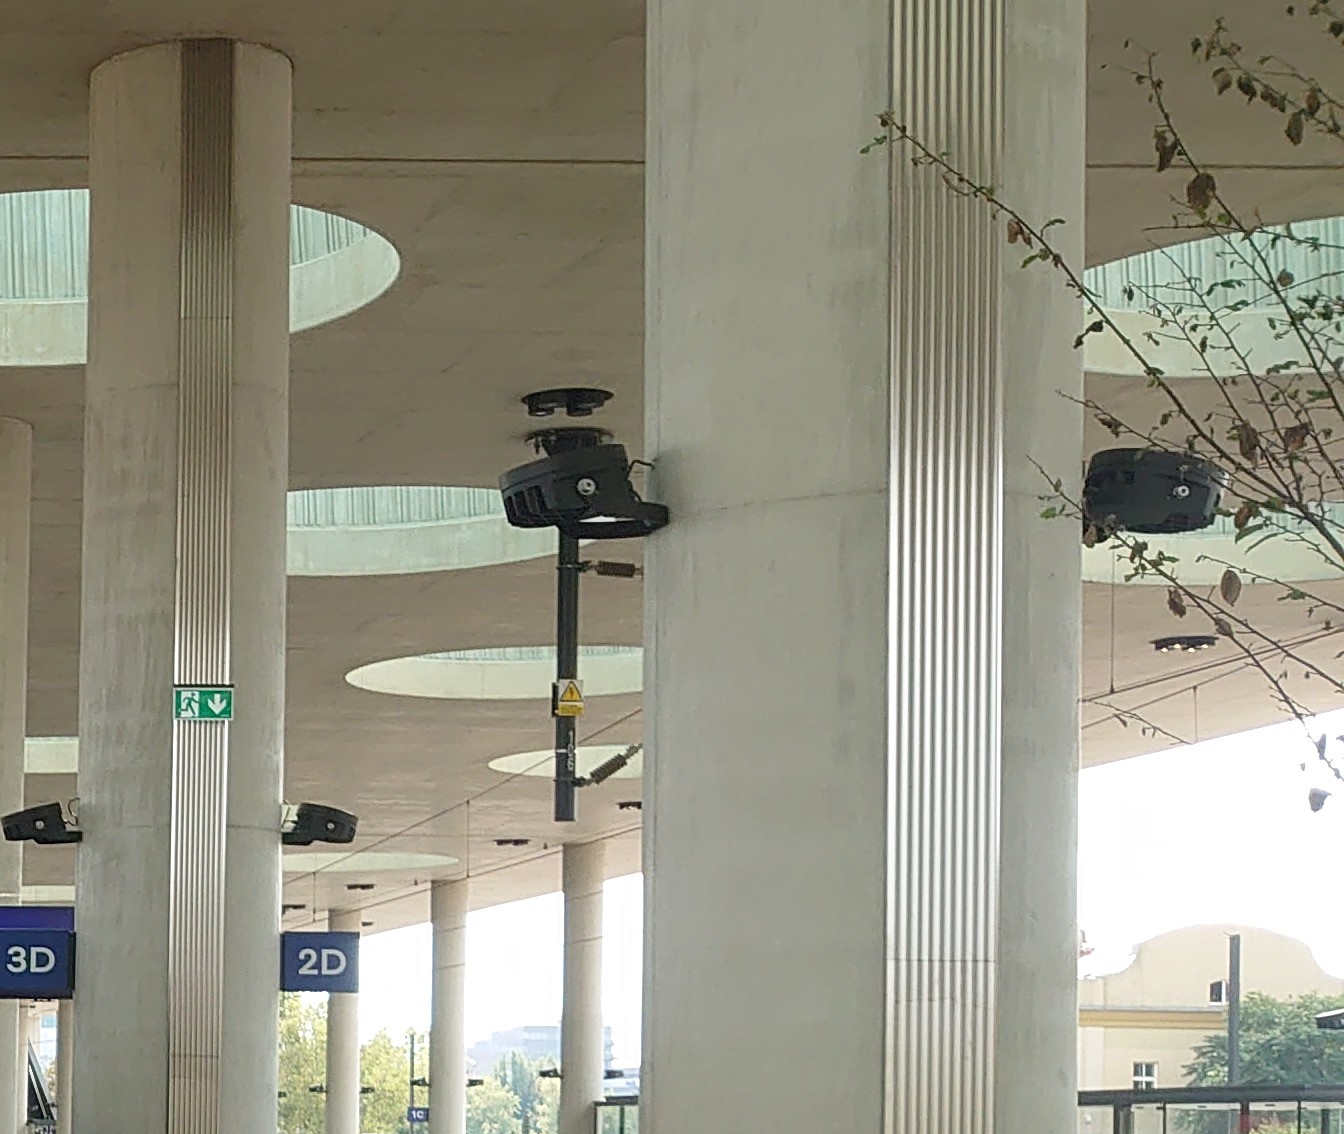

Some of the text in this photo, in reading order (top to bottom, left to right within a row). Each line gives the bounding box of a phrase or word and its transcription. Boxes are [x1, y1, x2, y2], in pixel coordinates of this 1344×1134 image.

[6, 946, 56, 974] 3D
[297, 948, 347, 976] 2D
[411, 1110, 424, 1120] 1C
